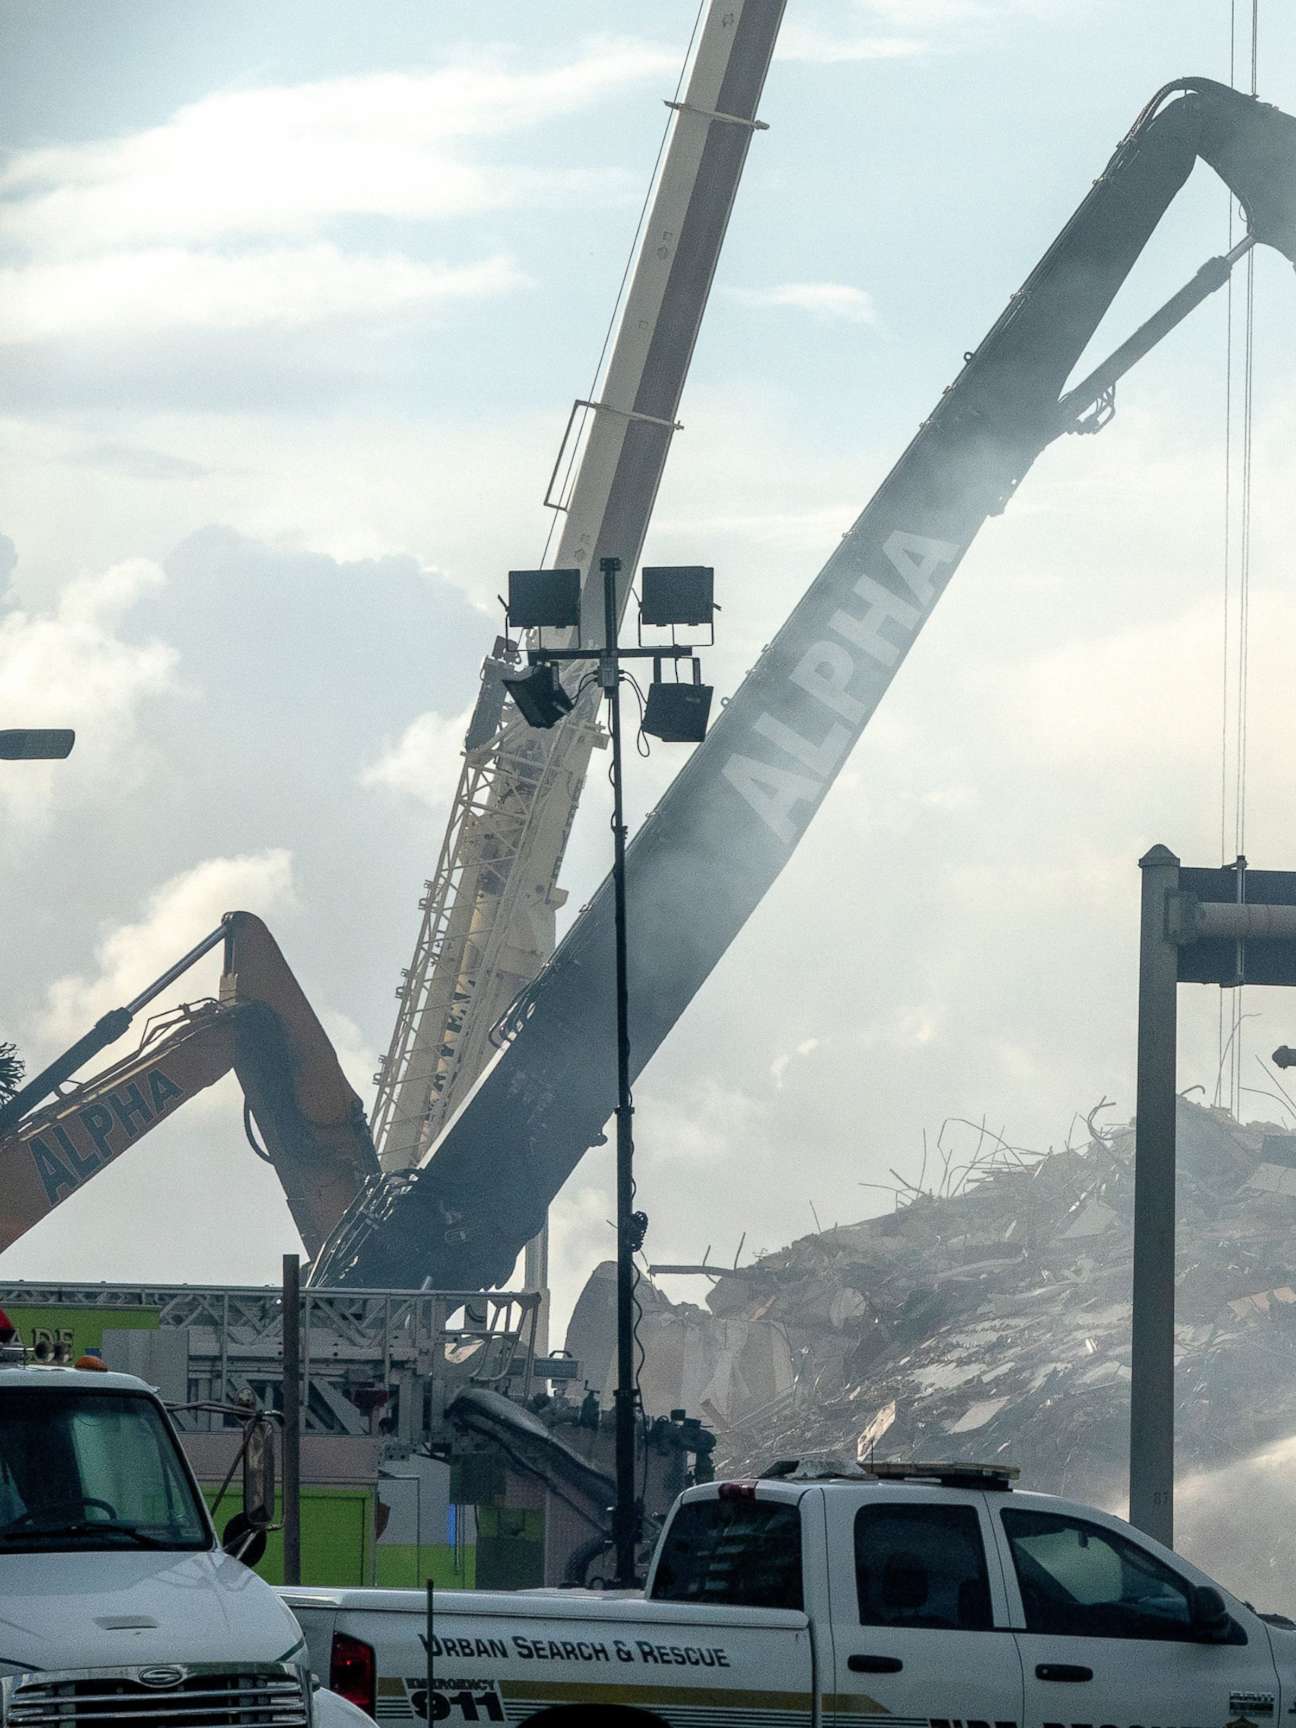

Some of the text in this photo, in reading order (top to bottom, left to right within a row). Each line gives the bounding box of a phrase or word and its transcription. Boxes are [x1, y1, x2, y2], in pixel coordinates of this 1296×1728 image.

[721, 529, 961, 844] ALPHA
[27, 1067, 185, 1208] ALPHA
[417, 1633, 732, 1668] URBAN SEARCH & RESCUE
[411, 1690, 505, 1722] 911
